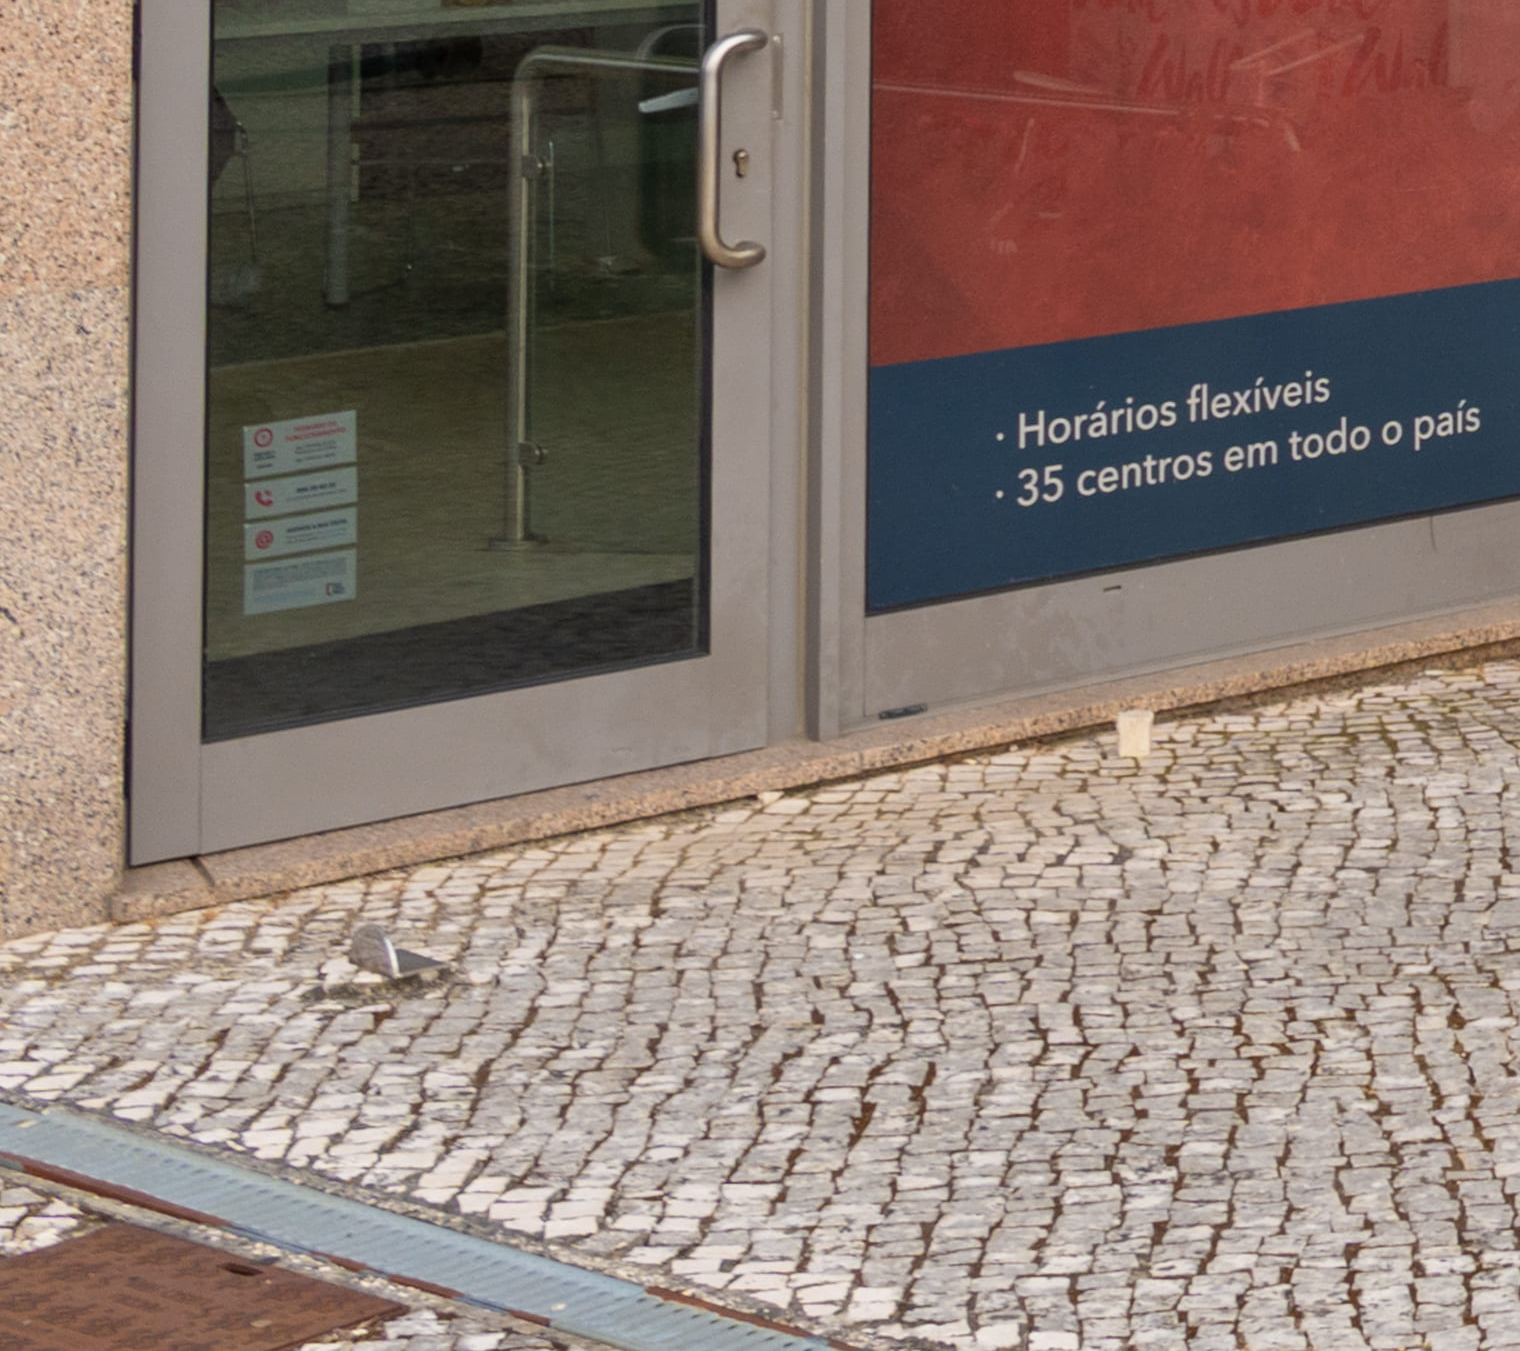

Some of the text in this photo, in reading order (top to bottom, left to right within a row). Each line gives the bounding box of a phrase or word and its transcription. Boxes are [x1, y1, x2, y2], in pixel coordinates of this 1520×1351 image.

[1016, 399, 1481, 507] 35 centros em todo o país
[1017, 370, 1331, 450] Horários flexíveis
